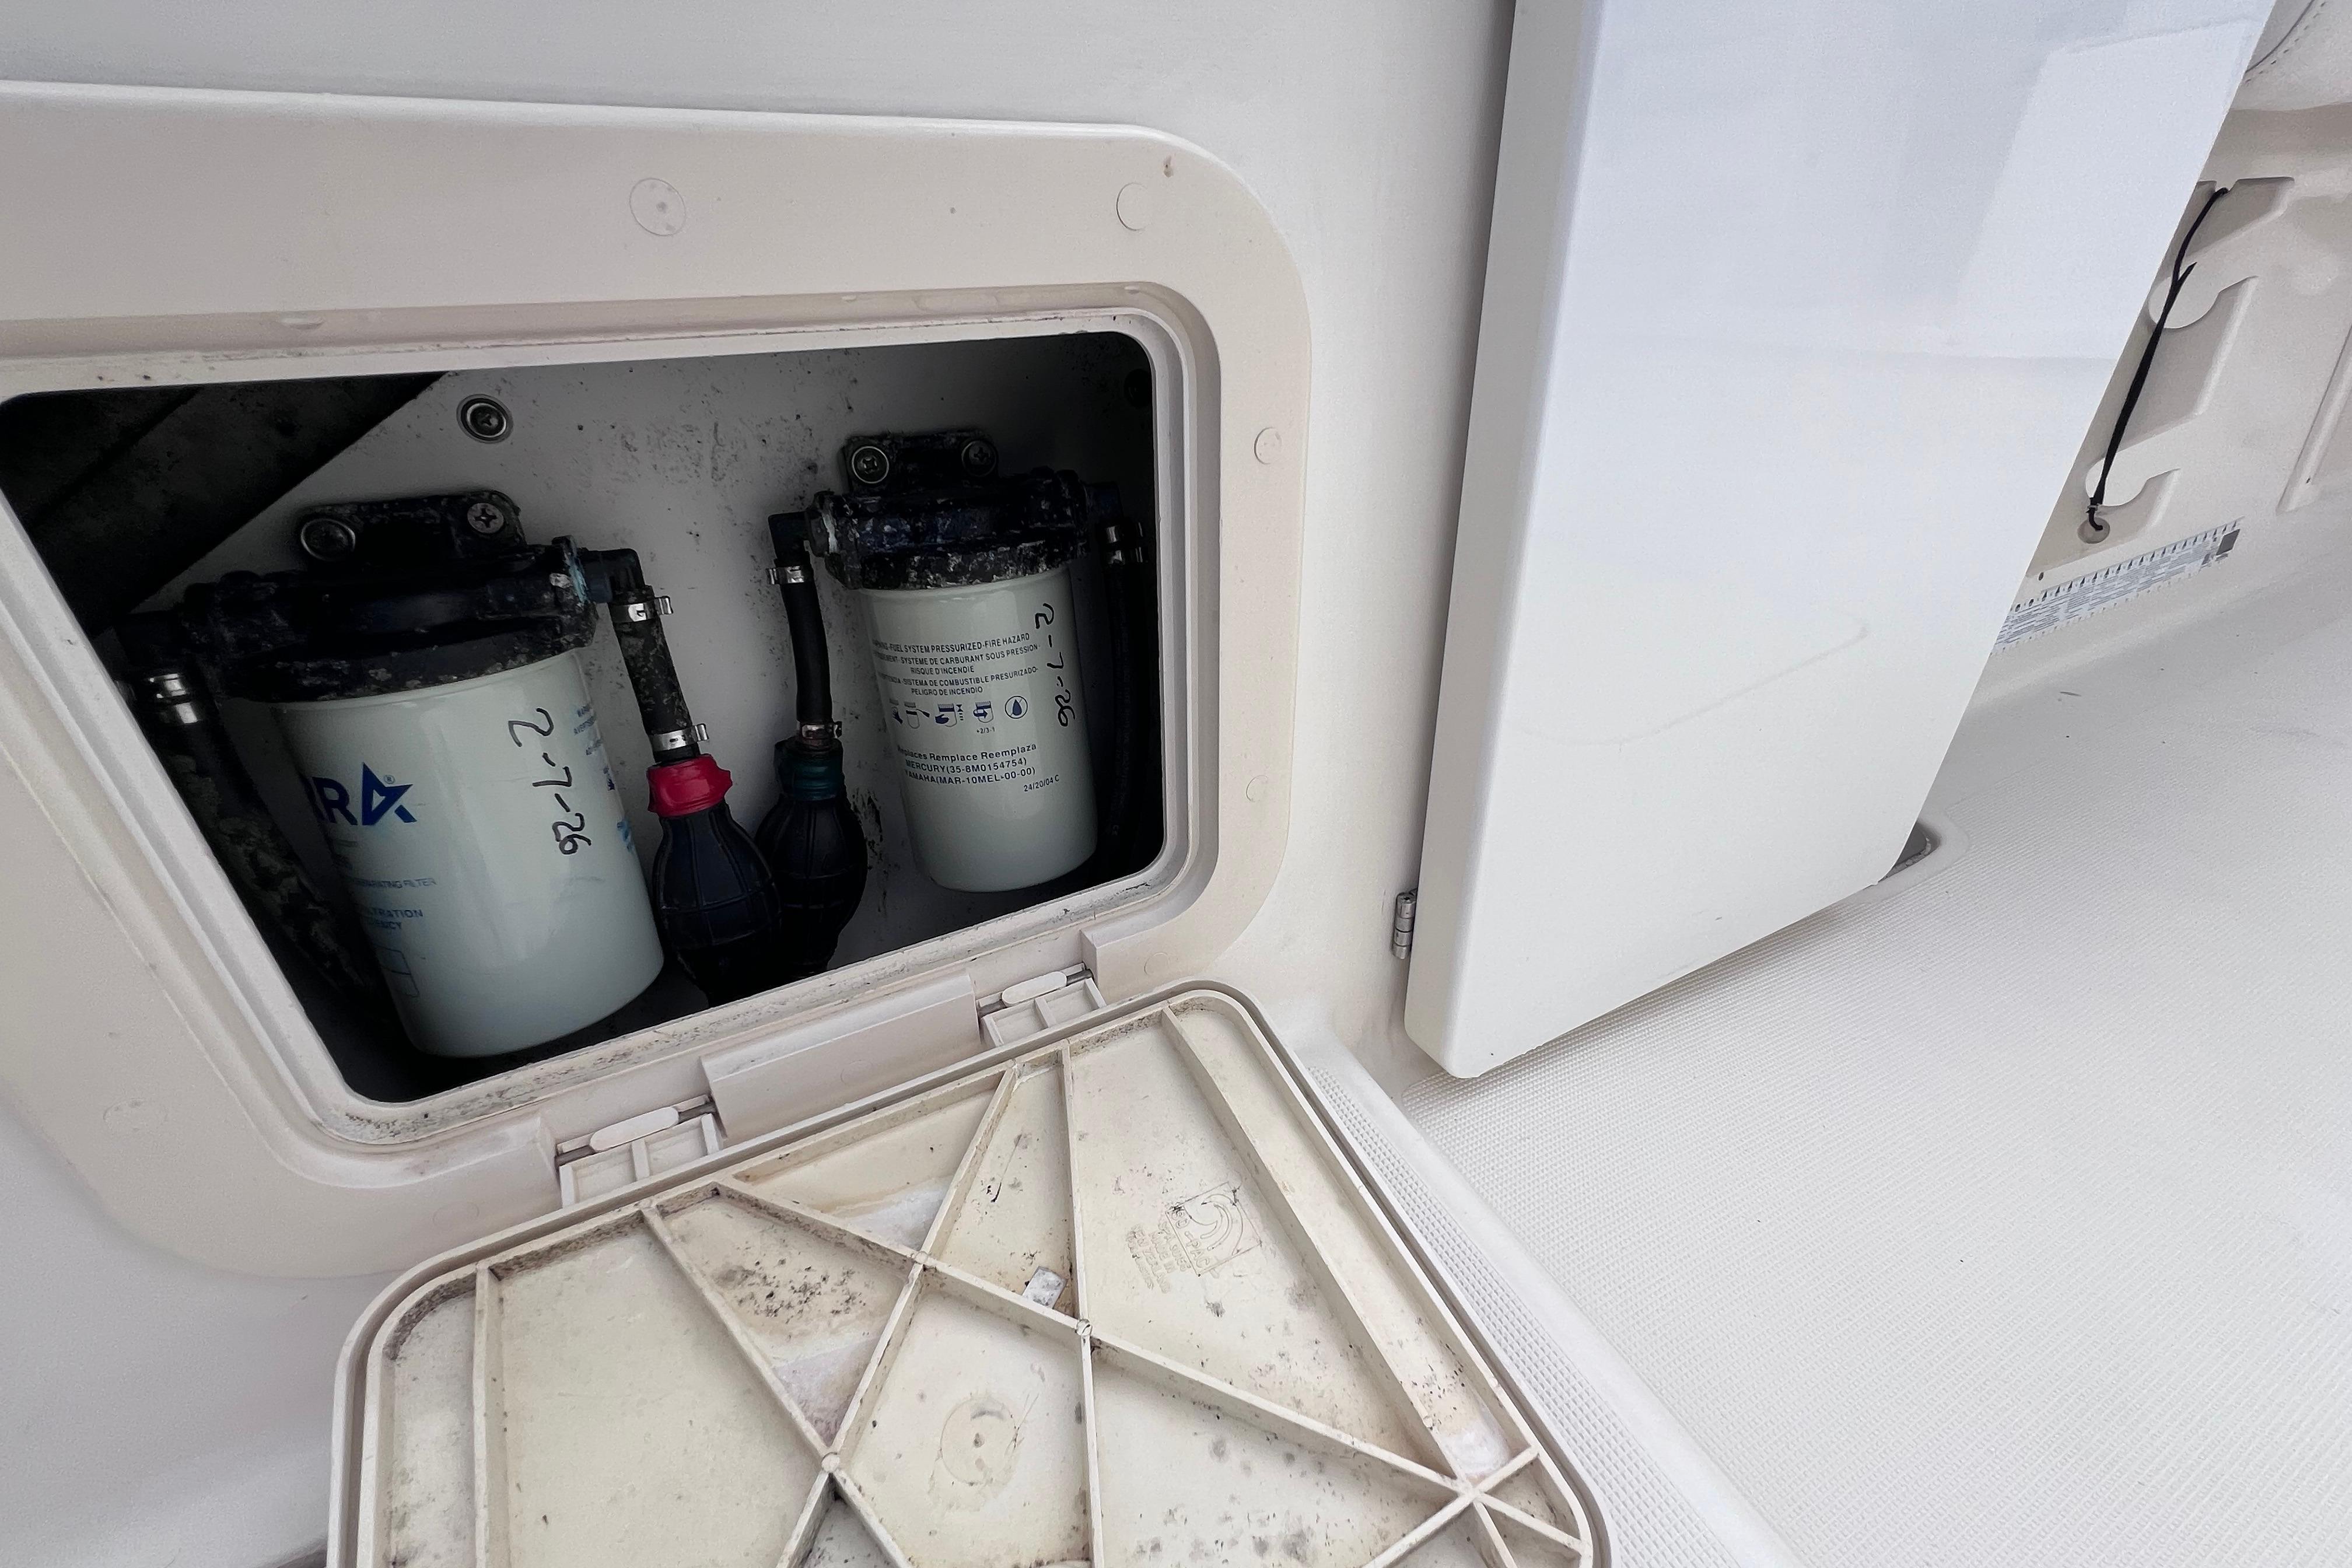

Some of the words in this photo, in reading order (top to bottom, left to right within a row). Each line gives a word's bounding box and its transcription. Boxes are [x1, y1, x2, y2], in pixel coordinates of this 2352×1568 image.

[905, 645, 930, 653] SYSTEM
[1002, 633, 1030, 646] HAZARD
[929, 657, 938, 666] DE
[940, 653, 983, 665] CARBURANT
[985, 652, 1005, 661] SOUS
[911, 667, 934, 675] RISQUE
[935, 666, 974, 674] D'INCENDIE
[928, 678, 938, 687] DE
[939, 676, 989, 687] COMBUSTIBLE
[911, 687, 937, 695] PELIGRO
[949, 687, 983, 695] INCENDIO
[929, 752, 978, 764] Remplace
[981, 743, 1037, 760] Reemplaza
[905, 757, 1027, 774] MERCURY(35-8M0154754)
[508, 708, 591, 855] 2-7-26
